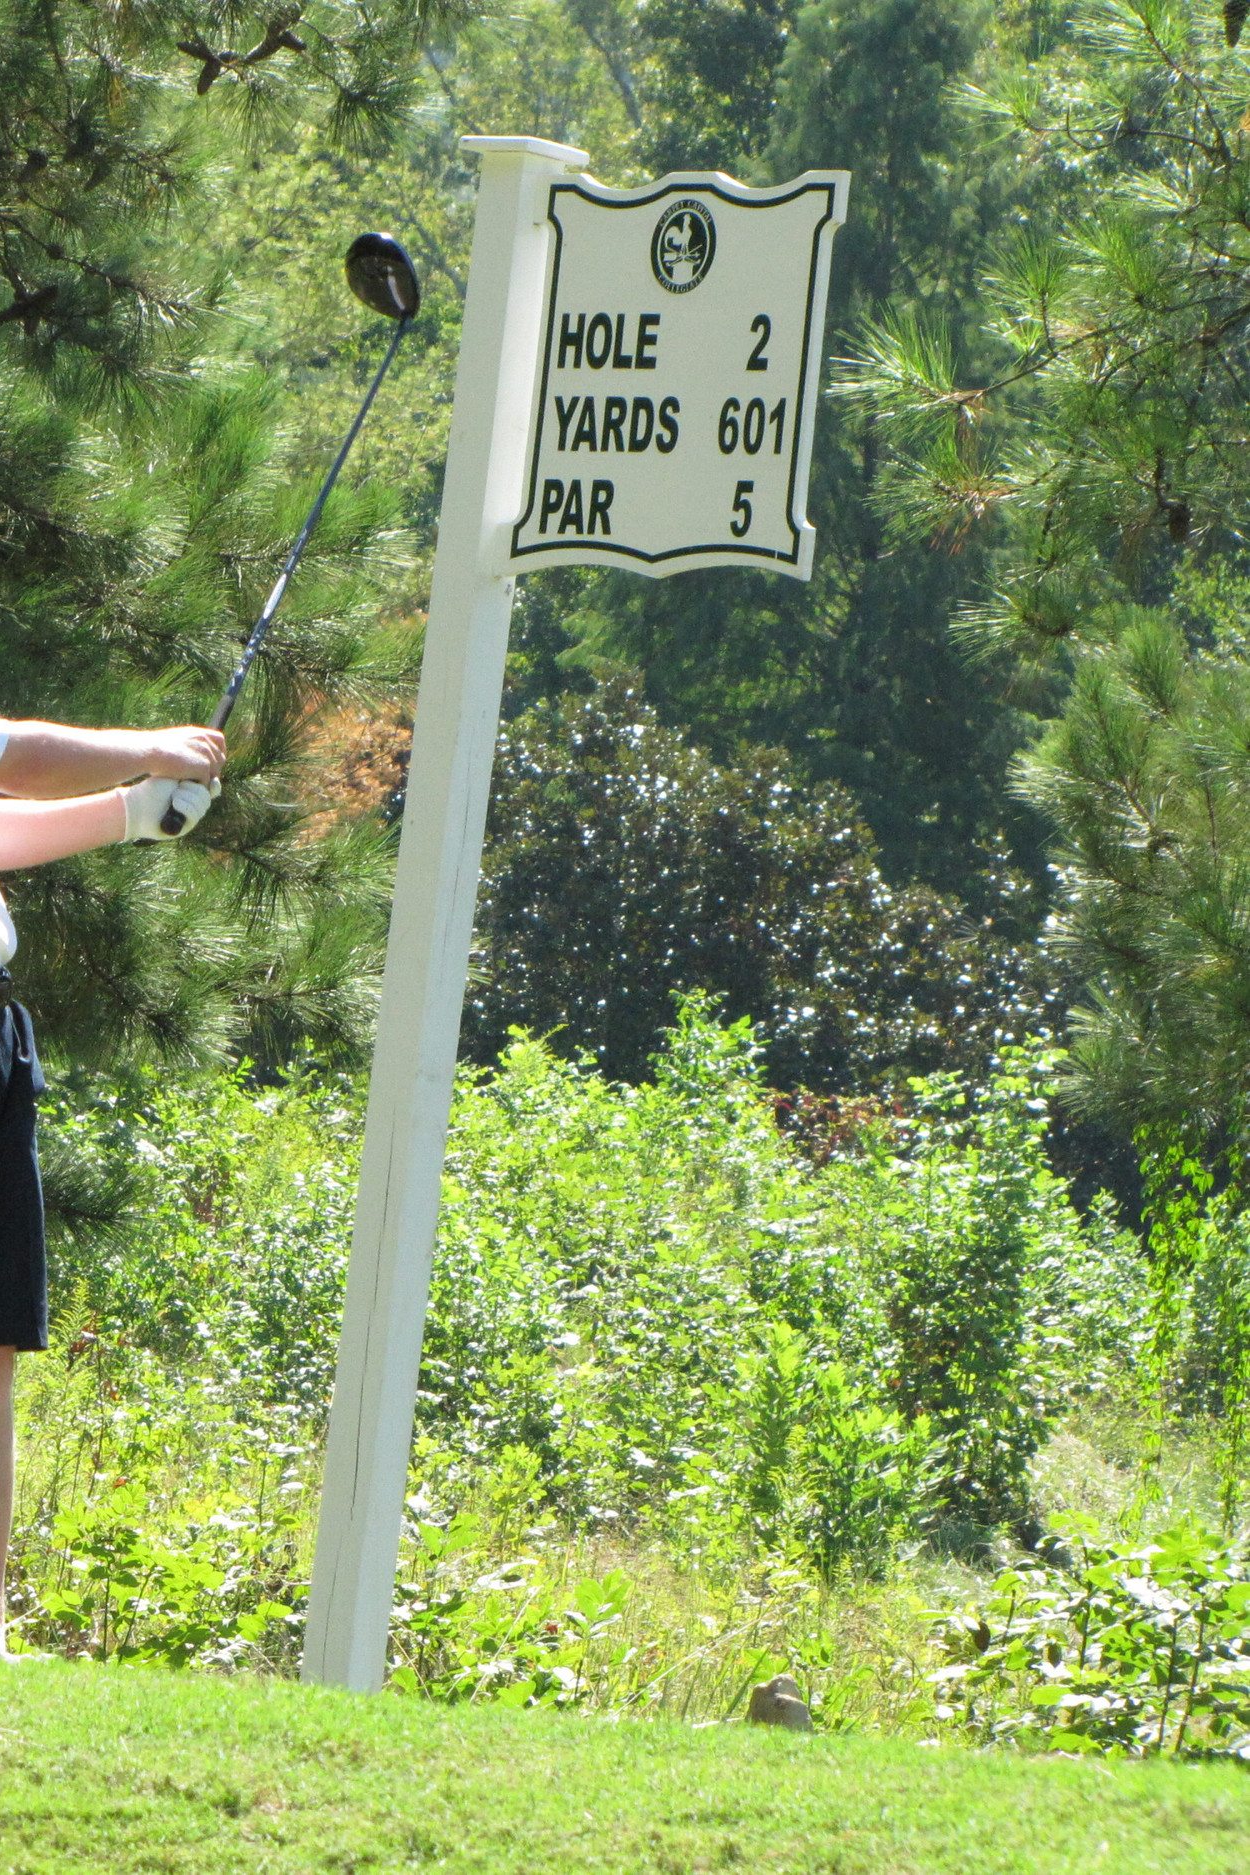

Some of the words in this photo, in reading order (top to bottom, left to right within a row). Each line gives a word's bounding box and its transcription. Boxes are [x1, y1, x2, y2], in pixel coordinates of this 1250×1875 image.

[659, 274, 704, 294] COLLEGIATE
[557, 312, 661, 370] HOLE
[745, 314, 772, 372] 2
[554, 395, 681, 454] YARDS
[718, 397, 787, 456] 601
[538, 478, 615, 536] PAR
[729, 480, 755, 538] 5
